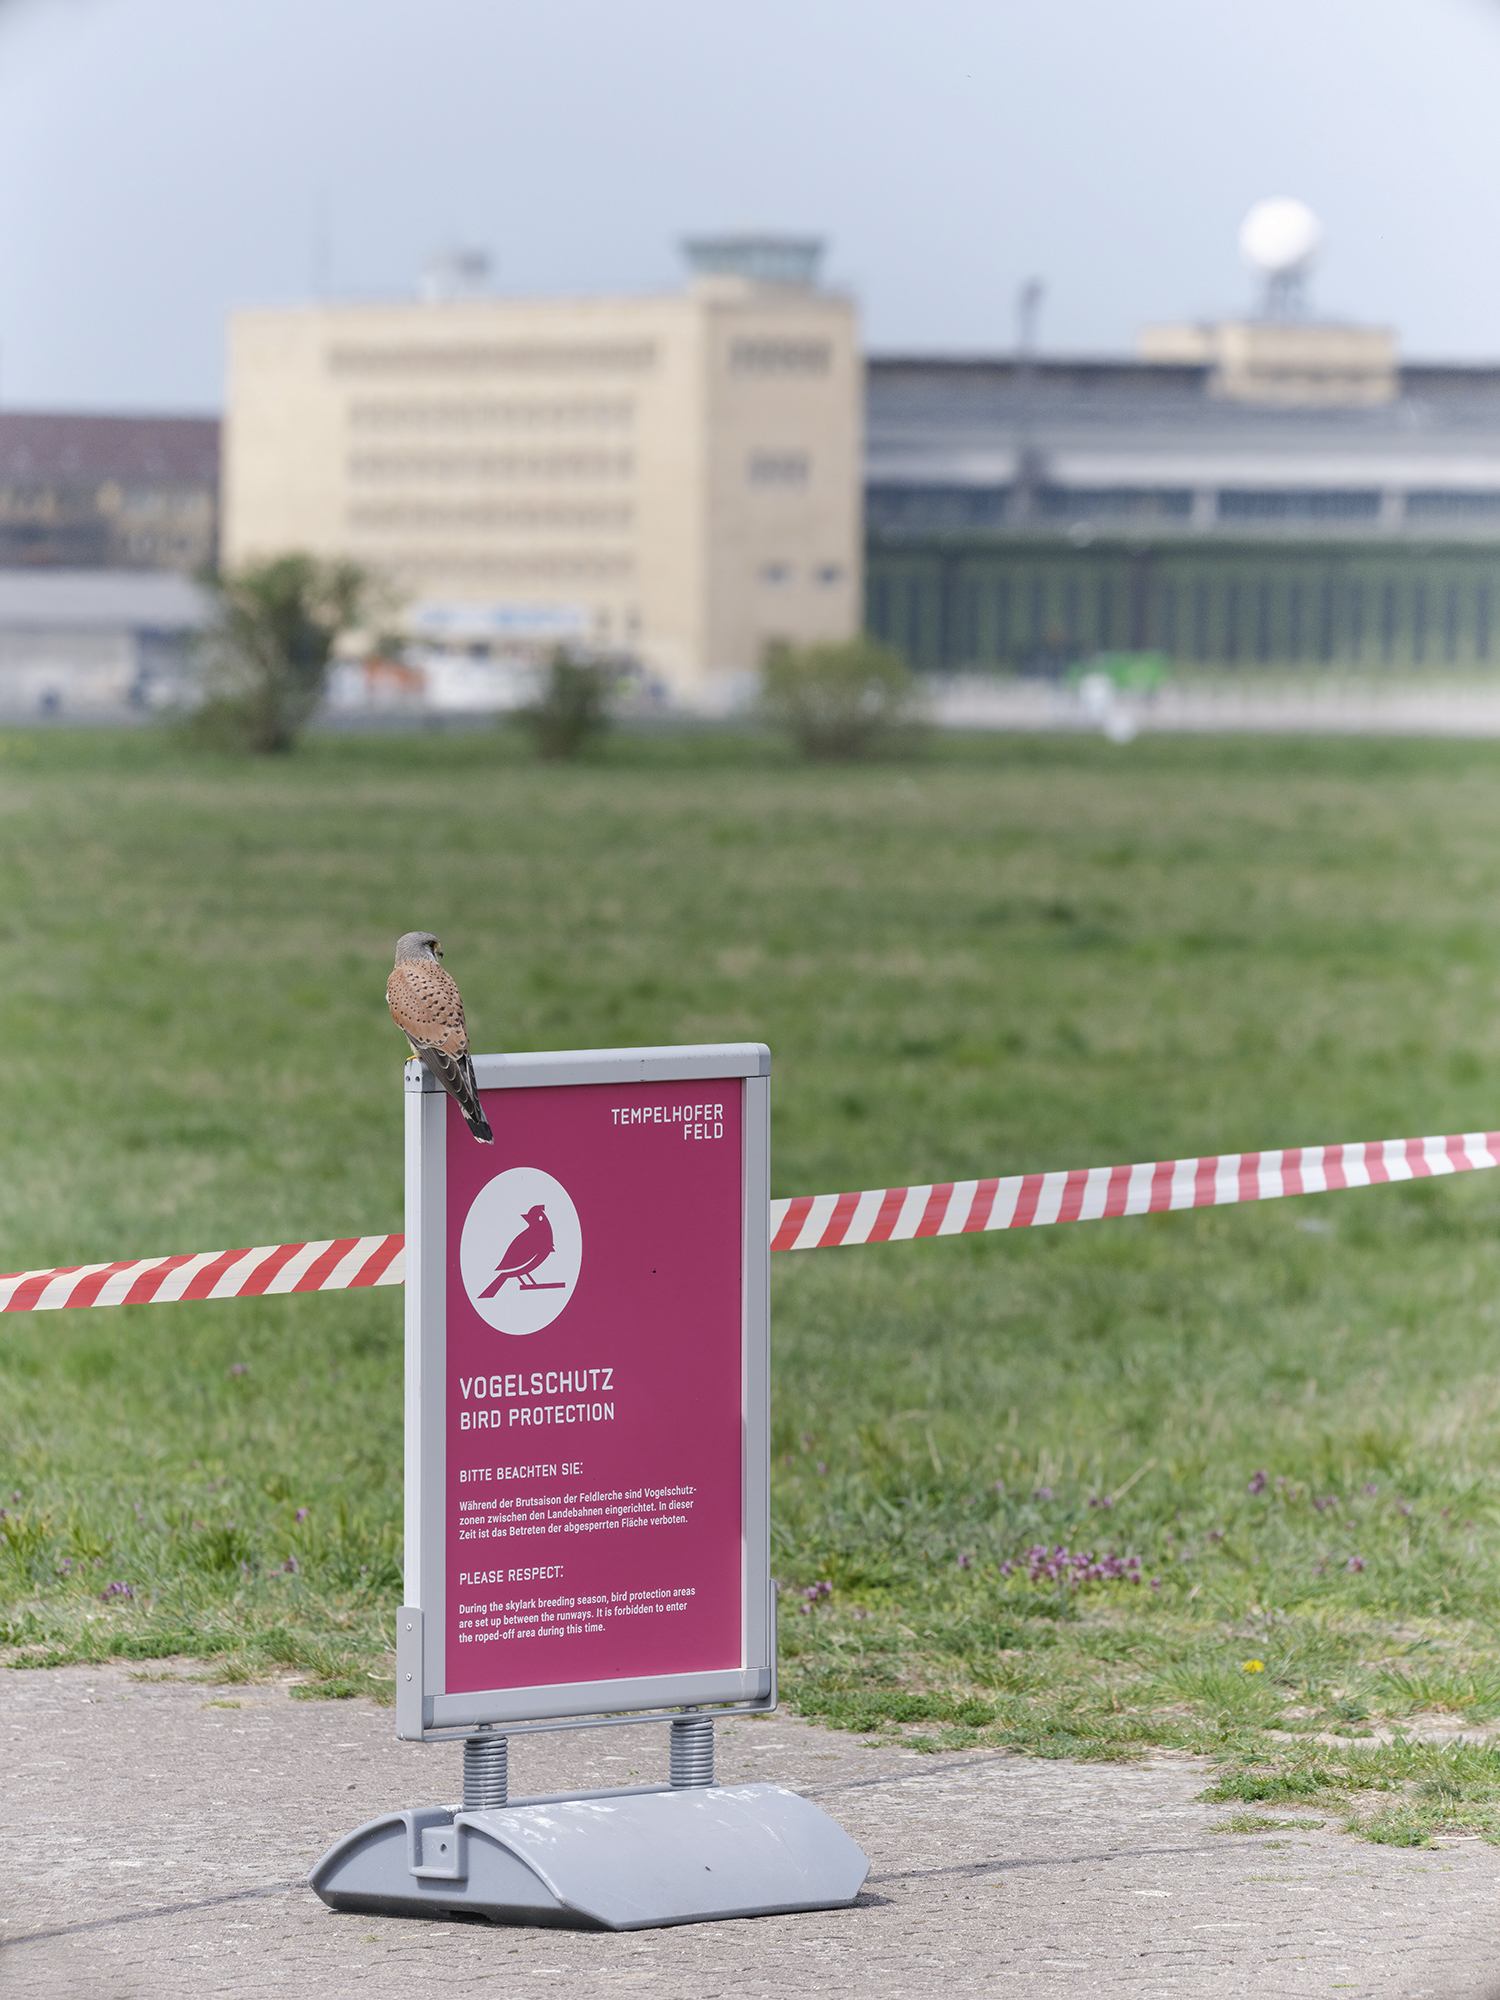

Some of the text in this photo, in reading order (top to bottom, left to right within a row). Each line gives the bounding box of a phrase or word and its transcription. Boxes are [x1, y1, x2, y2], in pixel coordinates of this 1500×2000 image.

[611, 1103, 723, 1125] TEMPELHOFER
[684, 1122, 724, 1141] FELD
[459, 1367, 614, 1400] VOGELSCHUTZ
[460, 1402, 615, 1430] BIRD PROTECTION
[459, 1462, 583, 1483] BITTE BEACHTEN SIE:
[459, 1485, 697, 1512] Während der Brutsaison der Feldlerche sind Vogelschutz-
[459, 1499, 694, 1526] zonen zwischen den Landebahnen eingerichtet. In dieser
[459, 1515, 688, 1540] Zeit ist das Betreten der abgesperrten Fläche verboten.
[459, 1565, 564, 1586] PLEASE RESPECT:
[459, 1587, 696, 1615] During the skylark breeding season, bird protection areas
[458, 1601, 688, 1629] are set up between the runways. It is forbidden to enter
[458, 1623, 606, 1644] the roped-off area during this time.
